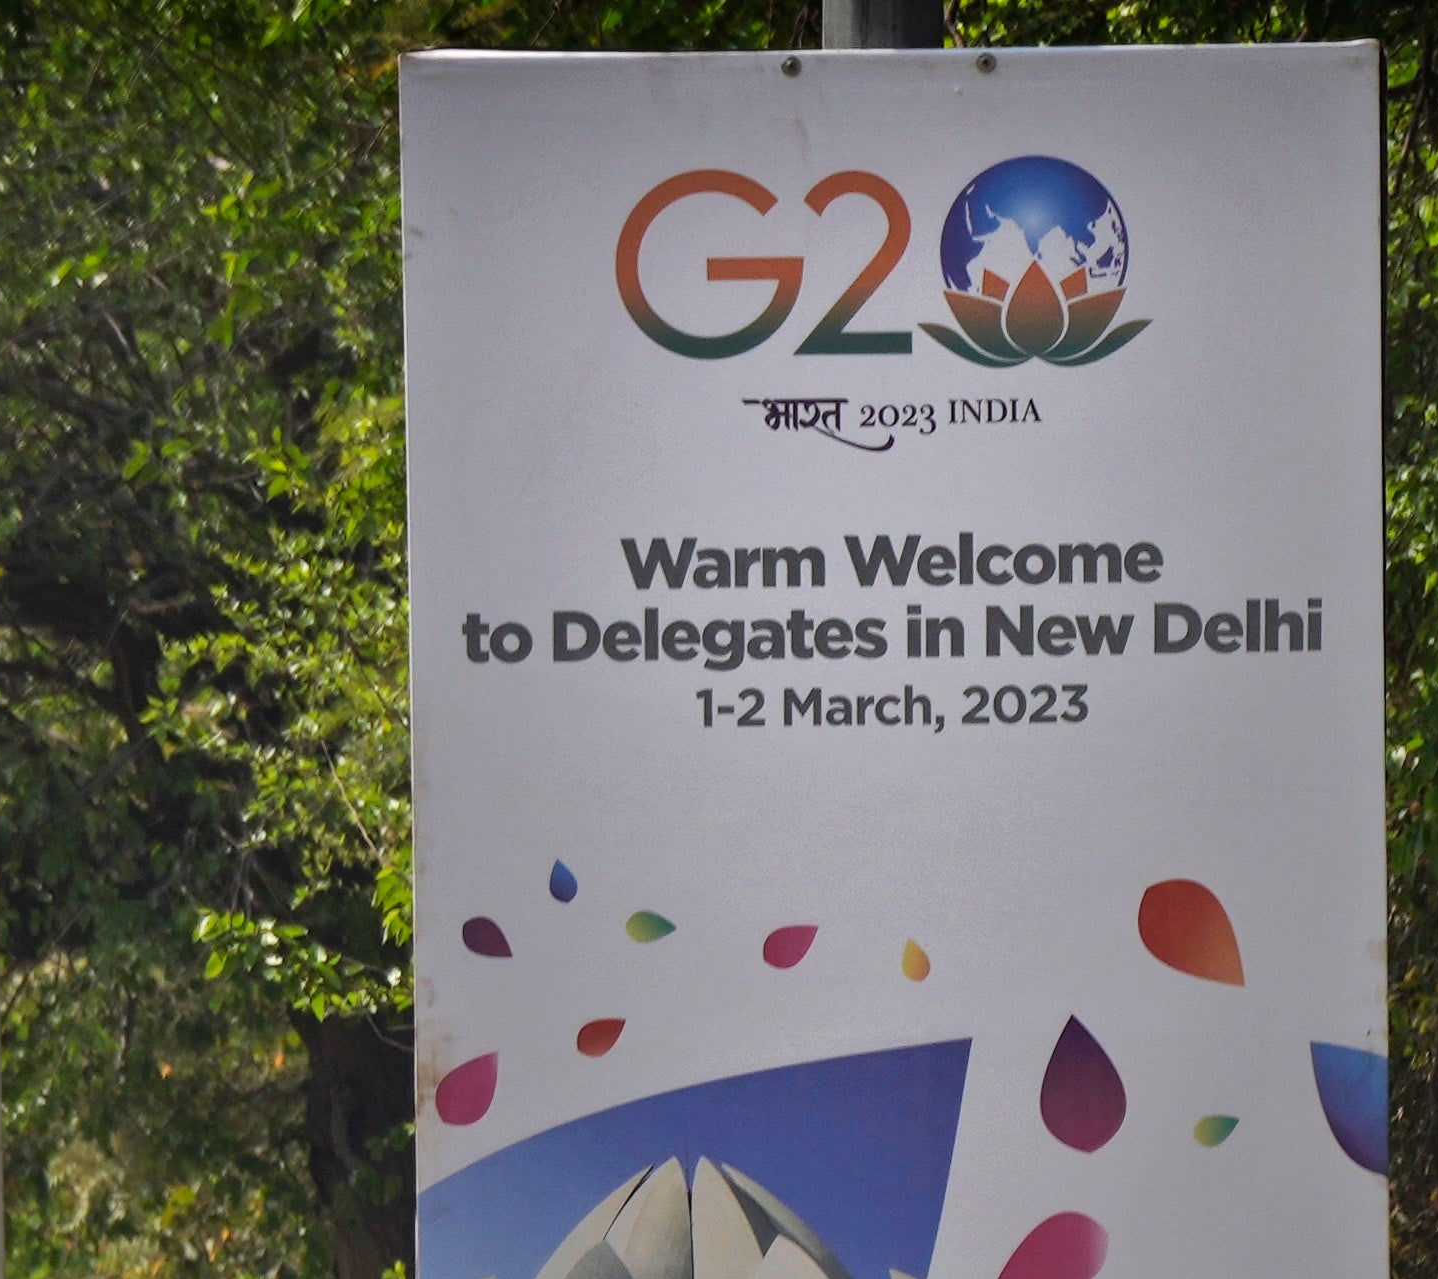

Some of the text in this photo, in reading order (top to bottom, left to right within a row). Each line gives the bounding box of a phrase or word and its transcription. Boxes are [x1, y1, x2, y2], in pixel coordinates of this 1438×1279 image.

[615, 154, 1152, 368] G20
[742, 398, 1042, 451] भारत 2023 INDIA
[620, 533, 1164, 590] Warm Welcome
[462, 599, 1323, 671] to Delegates in New Delhi
[696, 683, 1089, 734] 1-2 March, 2023
